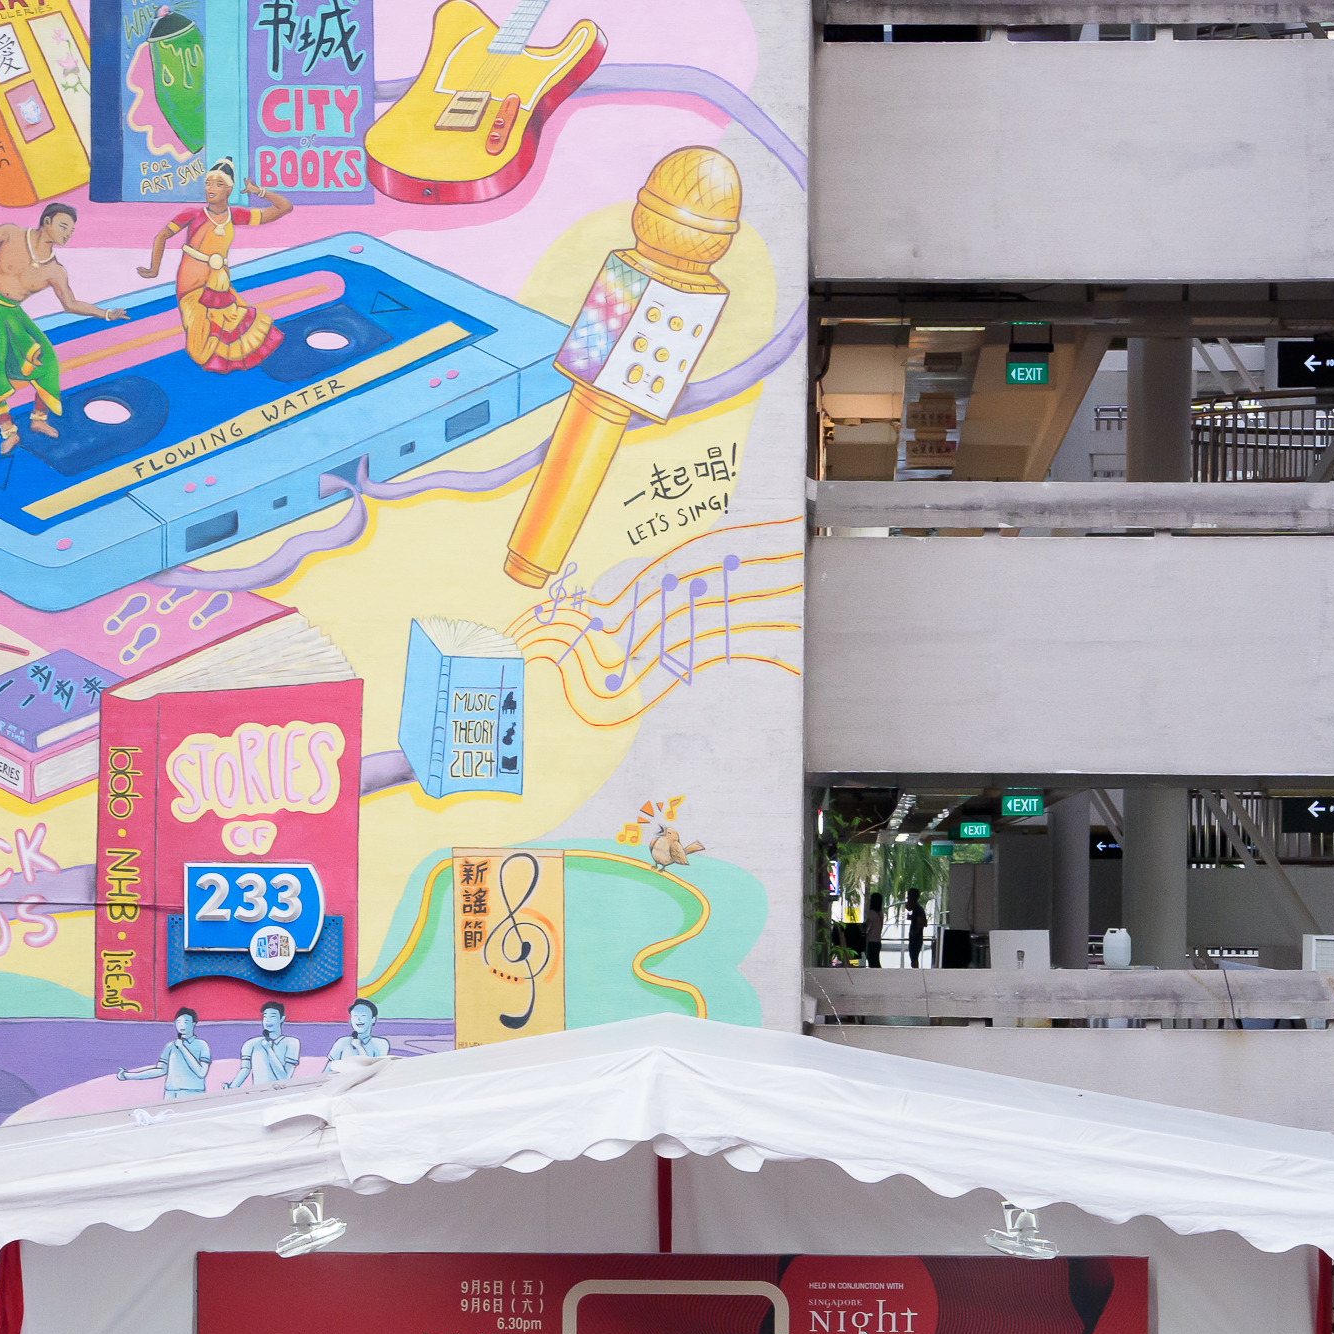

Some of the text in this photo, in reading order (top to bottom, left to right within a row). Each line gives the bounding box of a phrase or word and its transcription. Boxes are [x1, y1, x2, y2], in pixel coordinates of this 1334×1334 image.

[261, 88, 359, 133] CITY
[300, 135, 316, 147] of
[140, 161, 172, 176] FOR
[140, 158, 206, 196] ART SAKE
[259, 149, 362, 188] BOOKS
[1017, 368, 1042, 380] EXIT
[133, 379, 345, 478] FLOWING WATER
[623, 442, 737, 507] 一起唱!
[626, 492, 730, 546] LET'S SING!
[453, 693, 497, 713] MUSIC
[6, 730, 26, 745] TIME
[452, 720, 496, 744] THEORY
[172, 728, 335, 815] STORIES
[450, 751, 496, 778] 2024
[1014, 799, 1039, 812] EXIT
[230, 826, 271, 848] OF
[968, 826, 987, 836] EXIT
[106, 848, 141, 924] NHB
[195, 872, 303, 924] 233
[460, 859, 489, 949] 新謠節
[809, 1282, 904, 1290] HELD IN CONJUNCTION WITH
[497, 1317, 542, 1332] 6.30pm
